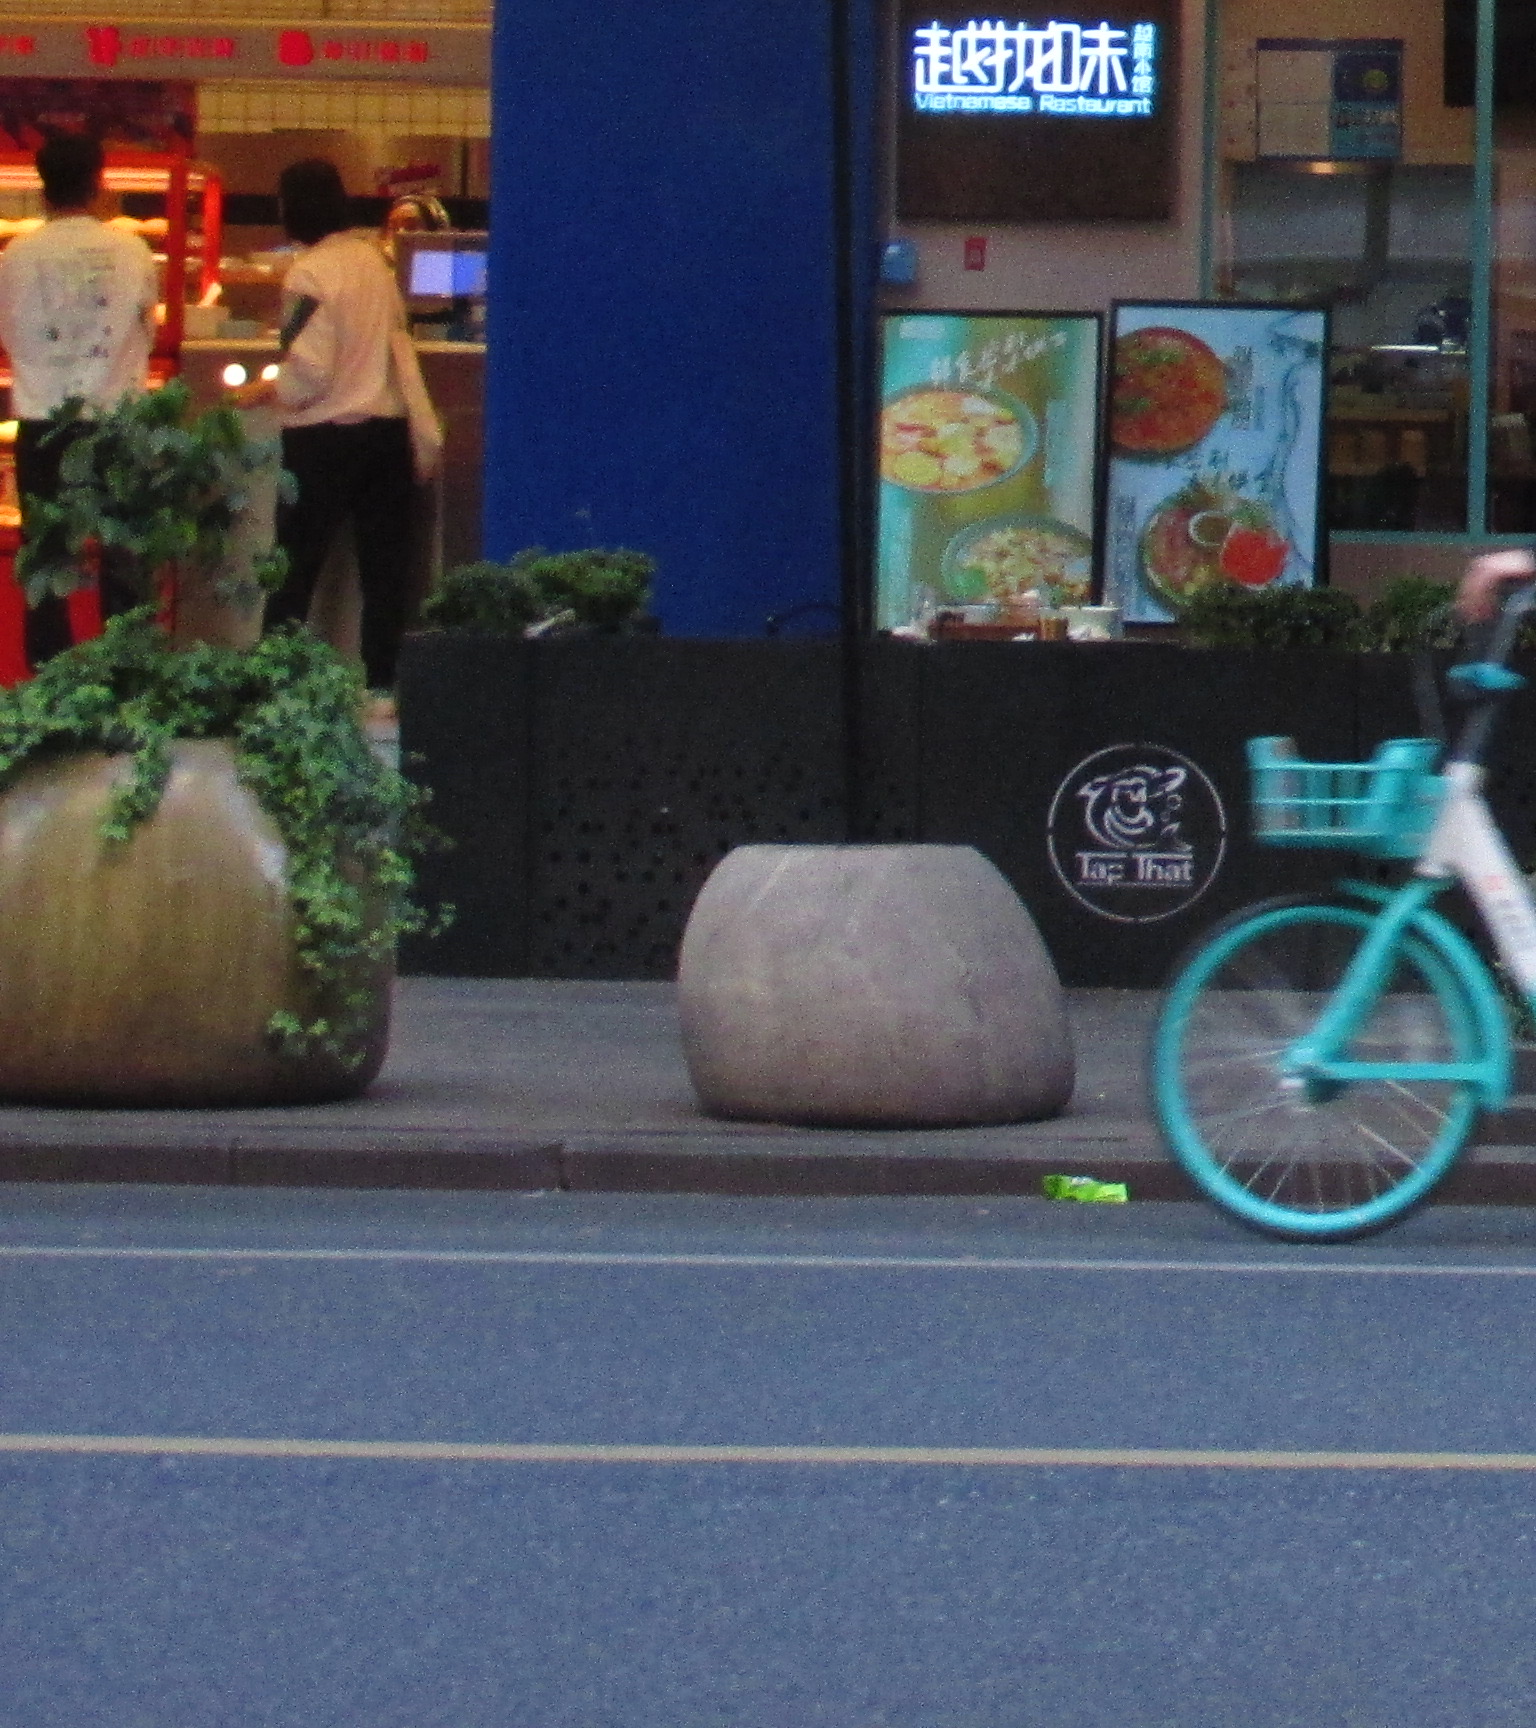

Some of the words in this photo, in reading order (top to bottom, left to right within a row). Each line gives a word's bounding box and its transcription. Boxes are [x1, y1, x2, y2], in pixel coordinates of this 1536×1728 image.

[915, 93, 1031, 111] Vietnamese
[1040, 95, 1152, 114] Restaurant
[1075, 851, 1129, 885] Tap
[1131, 852, 1193, 882] That
